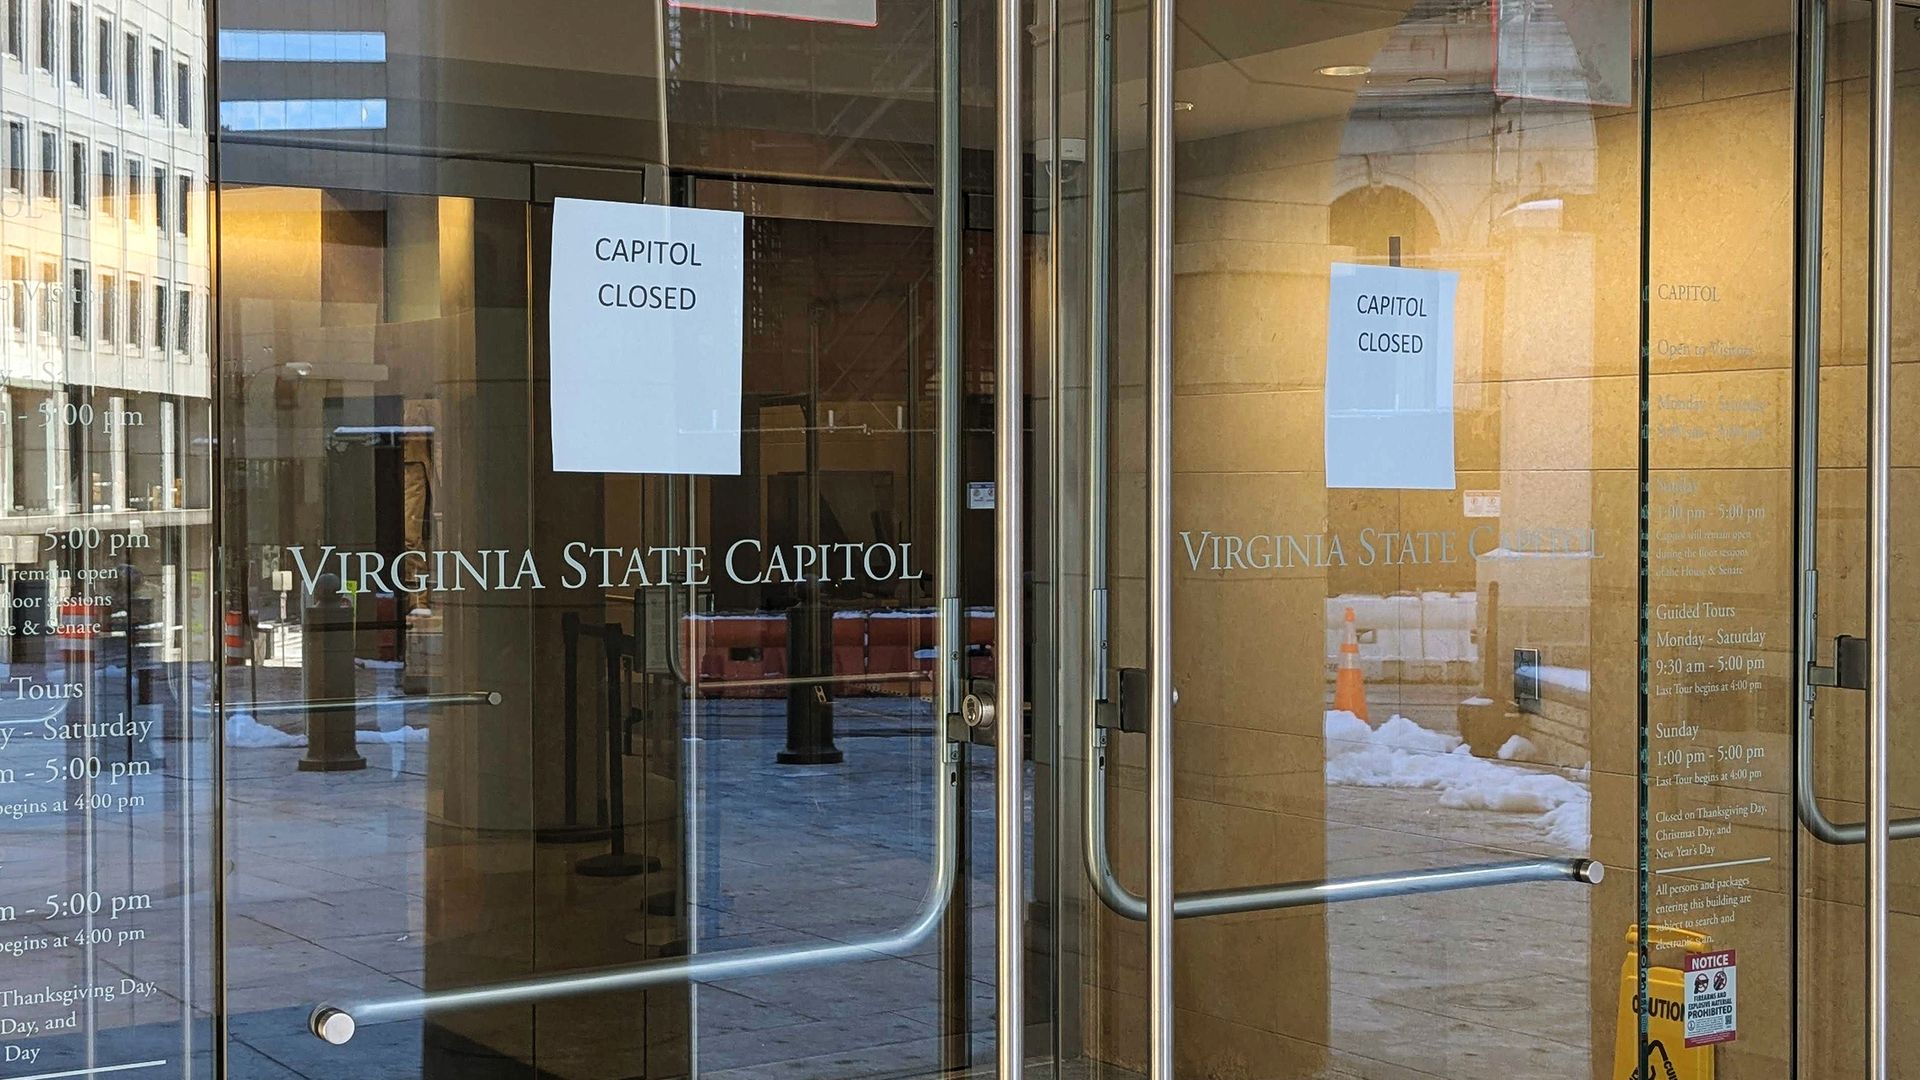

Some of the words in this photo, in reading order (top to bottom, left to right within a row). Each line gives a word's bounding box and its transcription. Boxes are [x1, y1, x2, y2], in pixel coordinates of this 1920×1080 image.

[595, 237, 702, 266] CAPITOL
[598, 284, 697, 310] CLOSED
[1658, 284, 1720, 302] CAPITOL
[1357, 295, 1427, 317] CAPITOL
[1358, 332, 1423, 353] CLOSED
[1687, 509, 1705, 524] pm
[1718, 504, 1743, 519] 5:00
[1746, 508, 1765, 524] pm
[44, 526, 100, 551] 5:00
[109, 532, 151, 556] pm
[77, 568, 118, 584] open
[287, 544, 545, 596] VIRGINIA
[560, 541, 709, 588] STATE
[725, 539, 924, 585] CAPITOL
[1718, 565, 1744, 576] Senate
[47, 592, 112, 607] sssions
[1656, 603, 1700, 620] Guided
[1703, 602, 1736, 618] Tours
[22, 620, 40, 635] &
[46, 620, 101, 634] Senate
[1656, 629, 1705, 650] Monday
[1717, 627, 1766, 648] Saturday
[1656, 658, 1682, 676] 9:30
[1686, 662, 1705, 673] am
[1718, 656, 1743, 672] 5:00
[1746, 658, 1765, 675] pm
[10, 676, 83, 700] Tours
[1656, 684, 1672, 696] Last
[1674, 683, 1692, 695] Tour
[1695, 682, 1719, 696] begins
[1720, 683, 1728, 692] at
[1730, 680, 1747, 691] 4:00
[1749, 681, 1762, 693] pm
[43, 712, 153, 743] Saturday
[1656, 720, 1699, 740] Sunday
[1657, 750, 1682, 766] 1:00
[1686, 754, 1705, 768] pm
[1718, 745, 1743, 761] 5:00
[1746, 747, 1764, 763] pm
[0, 767, 16, 784] m
[45, 756, 101, 783] 5:00
[110, 760, 151, 785] pm
[1656, 775, 1671, 787] Last
[1673, 773, 1692, 785] Tour
[1695, 771, 1720, 785] begins
[1721, 772, 1728, 781] at
[1730, 769, 1747, 780] 4:00
[1749, 770, 1762, 782] pm
[53, 798, 68, 812] at
[74, 793, 112, 810] 4:00
[118, 795, 145, 812] pm
[1656, 810, 1683, 823] Closed
[1685, 812, 1695, 820] on
[1697, 804, 1749, 820] Thanksgiving
[1656, 829, 1695, 842] Christmas
[1717, 824, 1731, 835] and
[1656, 849, 1673, 860] New
[1700, 844, 1715, 856] Day
[1656, 884, 1667, 896] All
[1669, 884, 1698, 898] persons
[1700, 878, 1715, 890] and
[1717, 875, 1750, 889] packages
[0, 906, 16, 921] m
[45, 892, 101, 919] 5:00
[110, 894, 151, 919] pm
[1656, 900, 1688, 914] entering
[1690, 898, 1704, 910] this
[1706, 894, 1738, 909] building
[1739, 895, 1751, 903] are
[1685, 920, 1694, 929] to
[1695, 913, 1719, 926] search
[1720, 911, 1735, 923] and
[53, 934, 68, 948] at
[74, 928, 112, 945] 4:00
[118, 928, 145, 946] pm
[1692, 954, 1729, 970] NOTICE
[0, 984, 115, 1007] Thanksgiving
[120, 978, 157, 995] Day,
[1717, 991, 1727, 1000] AND
[1632, 994, 1685, 1022] CUTIO
[1687, 1005, 1733, 1020] PROHIBITED
[1, 1018, 39, 1036] Day,
[45, 1011, 76, 1028] and
[5, 1045, 40, 1062] Day
